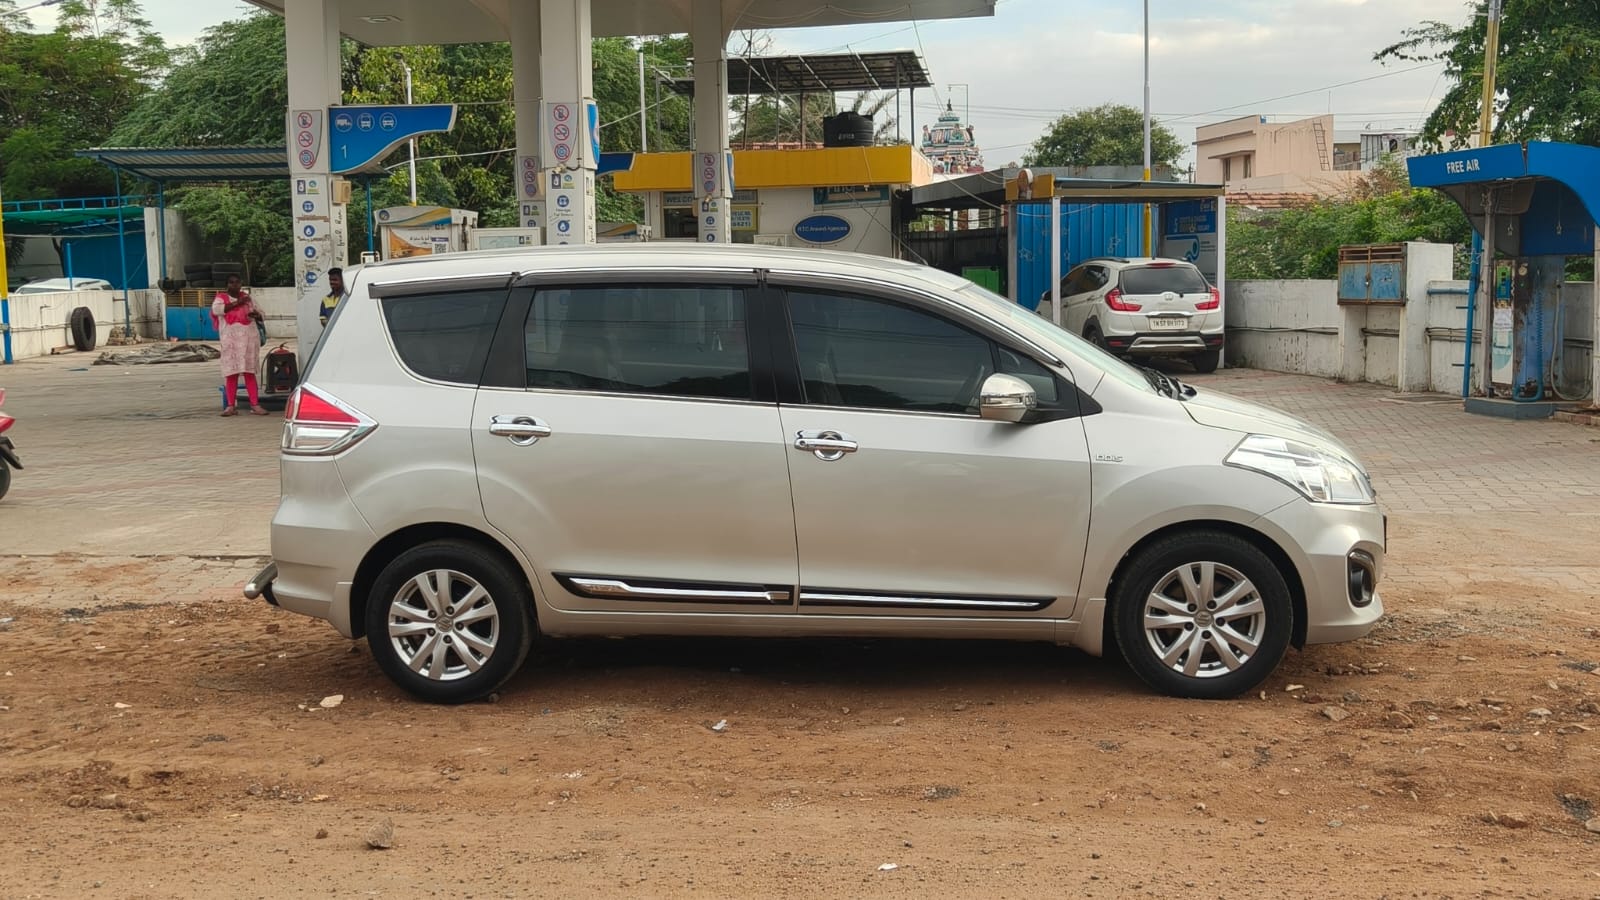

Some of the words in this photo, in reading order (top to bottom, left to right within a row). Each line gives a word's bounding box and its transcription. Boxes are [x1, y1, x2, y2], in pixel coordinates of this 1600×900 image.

[341, 145, 347, 159] 1
[1446, 161, 1464, 174] FREE
[1466, 159, 1480, 171] AIR
